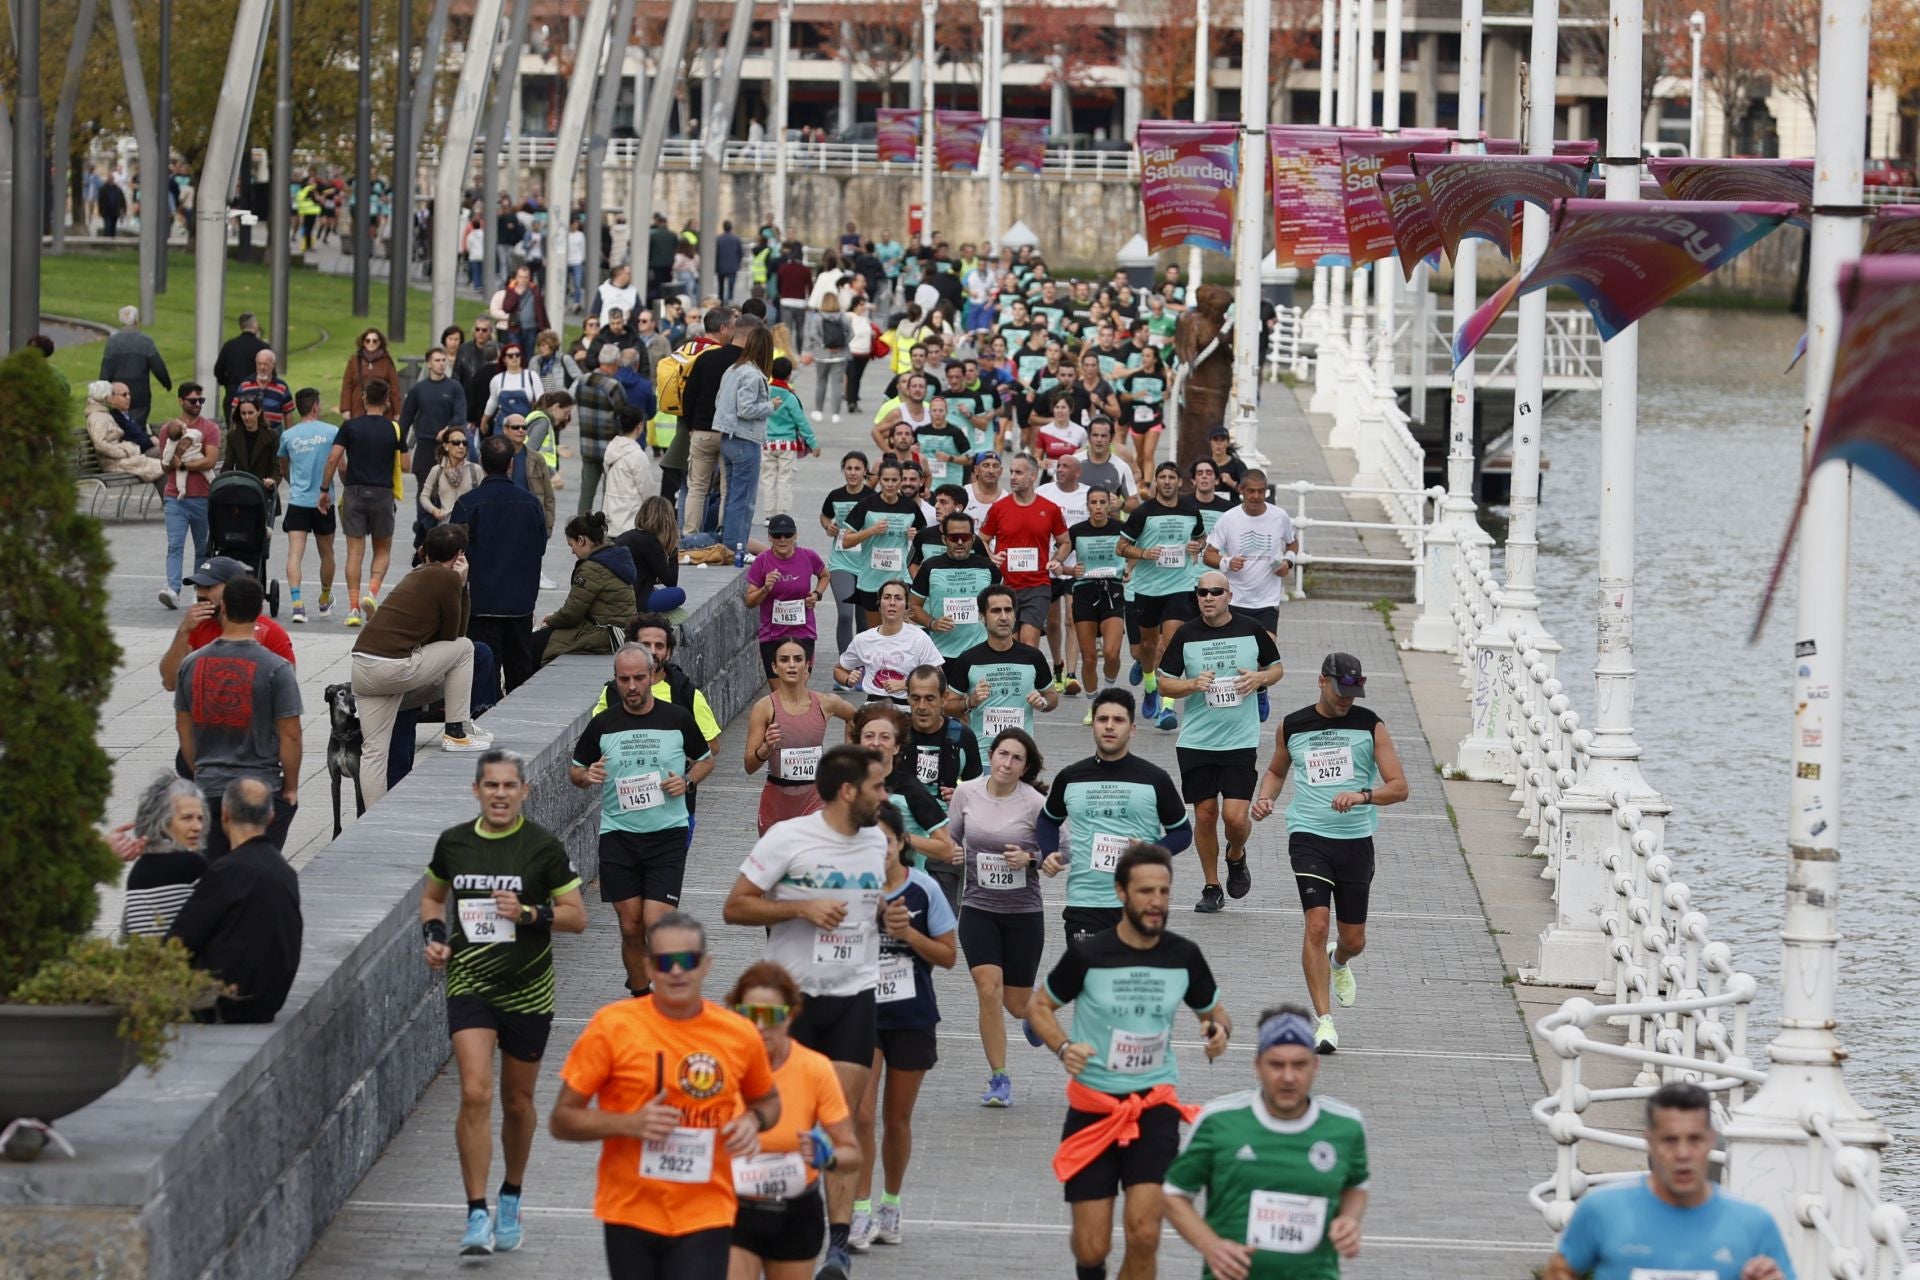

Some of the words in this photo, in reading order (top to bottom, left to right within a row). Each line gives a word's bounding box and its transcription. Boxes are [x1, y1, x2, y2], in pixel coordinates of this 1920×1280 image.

[1142, 145, 1178, 166] Fair
[1346, 154, 1384, 174] Fair
[1145, 161, 1234, 188] Saturday
[1388, 181, 1417, 205] Fa
[880, 560, 892, 568] 402
[1018, 560, 1028, 568] 401
[781, 614, 798, 622] 1635
[953, 612, 970, 620] 1167
[1216, 693, 1236, 702] 1139
[1309, 760, 1327, 768] XXXVI
[792, 766, 814, 776] 2140
[1318, 766, 1341, 779] 2472
[620, 786, 637, 794] XXXVI
[629, 792, 651, 806] 1451
[1097, 844, 1117, 853] XXXVI
[1104, 854, 1116, 866] 21
[981, 864, 1000, 872] XXXVI
[990, 872, 1014, 884] 2128
[462, 912, 483, 920] XXXVI
[475, 922, 495, 935] 264
[820, 934, 844, 944] XXXVI
[834, 946, 852, 958] 761
[876, 982, 896, 996] 762
[1125, 1054, 1153, 1067] 2144
[659, 1155, 694, 1172] 2022
